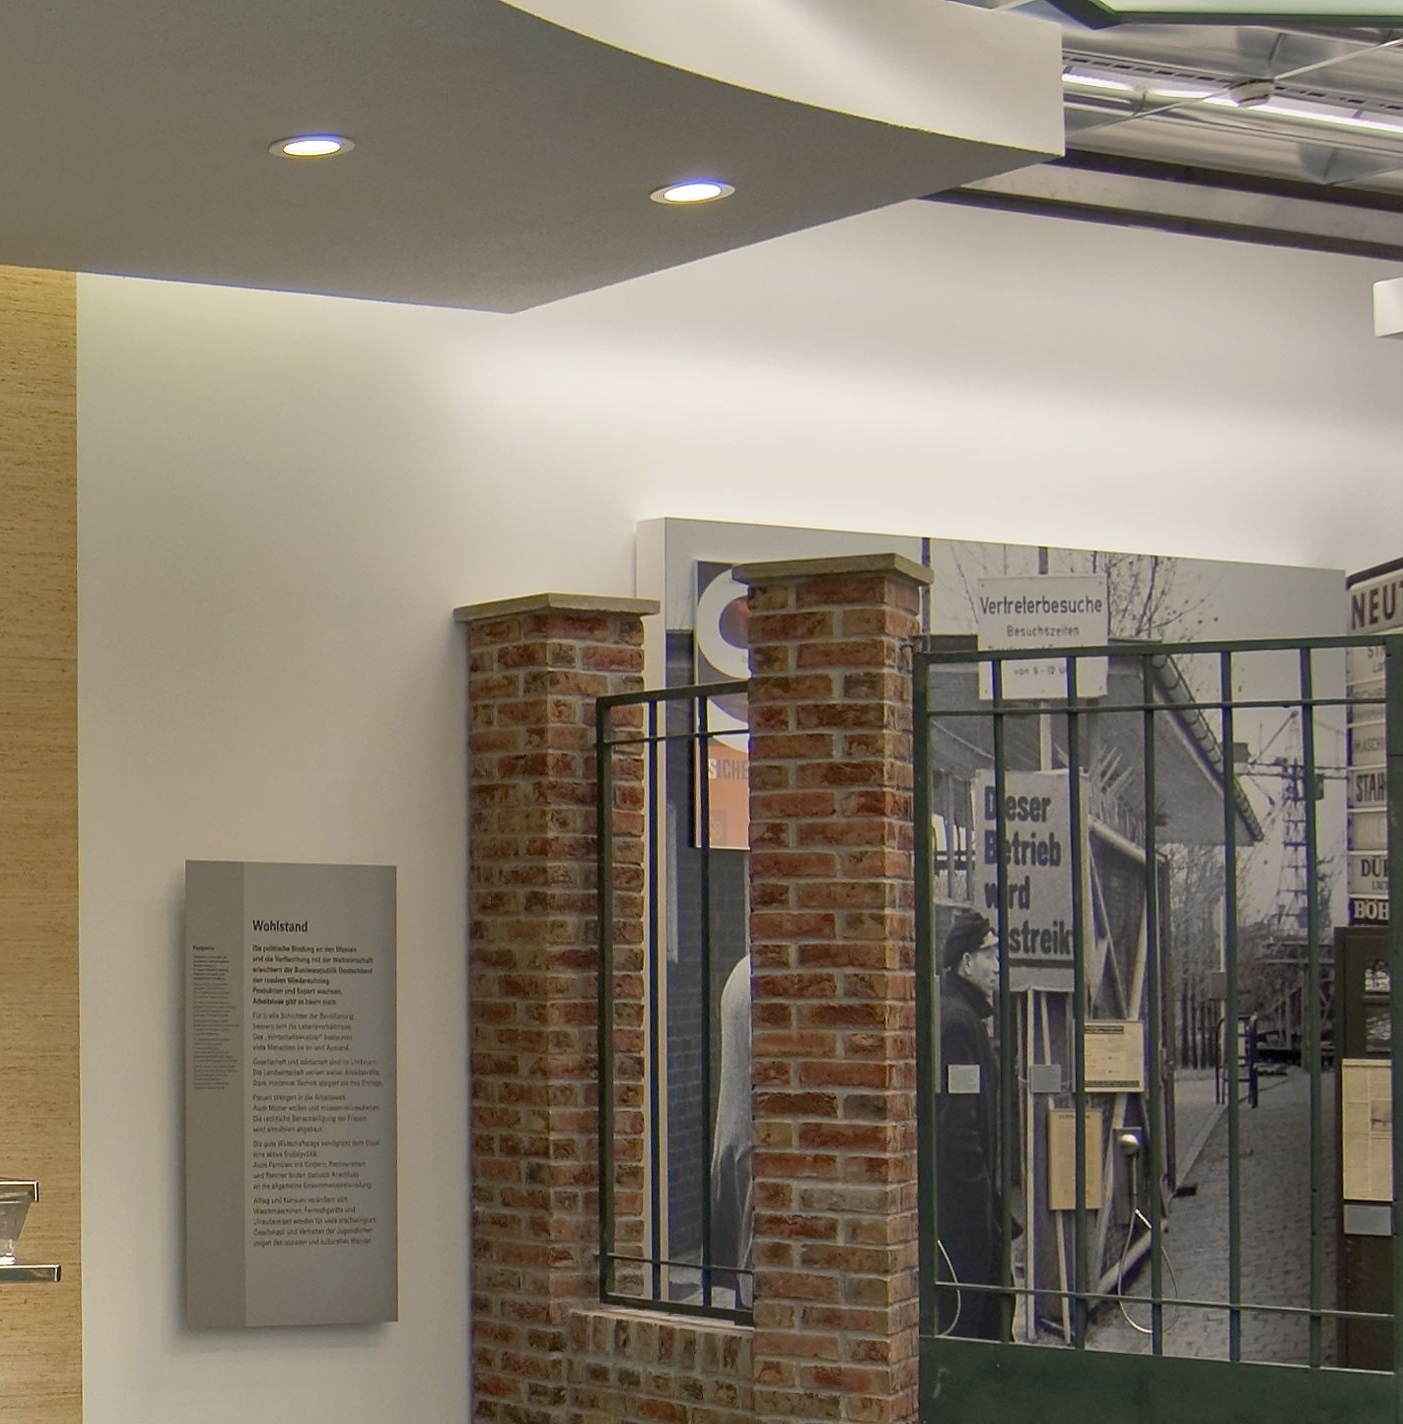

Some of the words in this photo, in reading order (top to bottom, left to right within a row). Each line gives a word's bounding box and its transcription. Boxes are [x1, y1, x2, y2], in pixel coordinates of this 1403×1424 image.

[980, 595, 1102, 615] Vertreterbesuche
[1007, 625, 1079, 637] Besuchszeiten
[984, 785, 1051, 822] Deser
[984, 875, 1031, 910] wrd
[252, 919, 308, 932] Wohlstand
